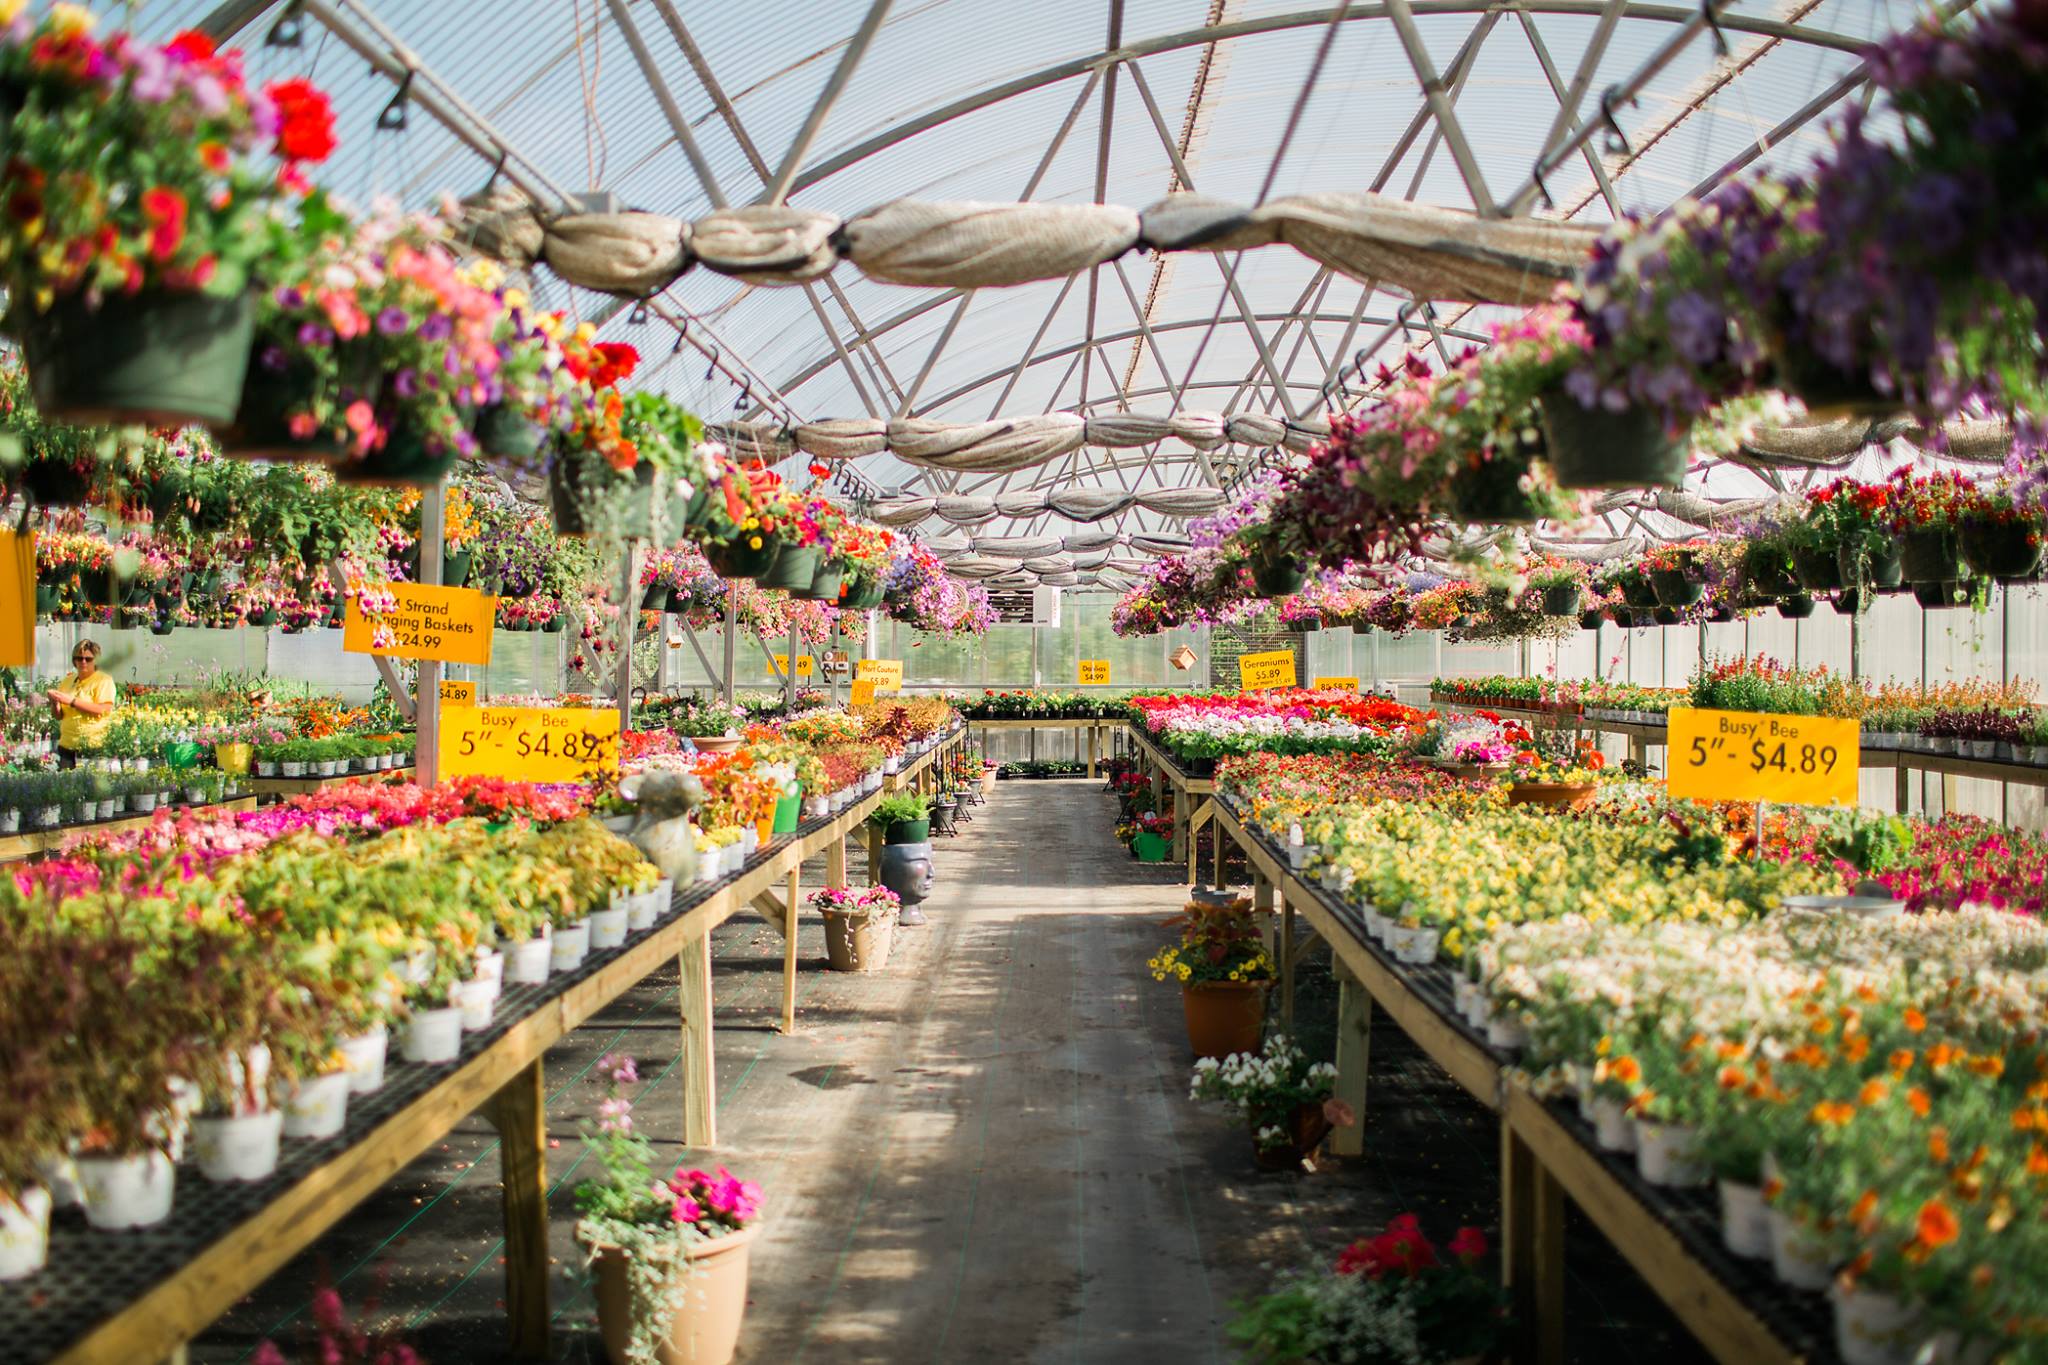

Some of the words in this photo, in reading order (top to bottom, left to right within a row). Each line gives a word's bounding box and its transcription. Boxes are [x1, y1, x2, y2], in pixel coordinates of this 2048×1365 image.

[405, 599, 449, 615] Strand
[363, 610, 420, 631] Hnging
[424, 616, 474, 633] Baskets
[1244, 658, 1290, 669] Geraniums
[1255, 669, 1281, 680] $5.89
[439, 688, 468, 700] $4.89
[481, 711, 517, 730] Busy
[541, 713, 569, 727] Bee
[1719, 716, 1758, 740] Busy
[1770, 720, 1799, 739] Bee
[516, 729, 598, 759] $4.89
[1749, 737, 1838, 775] $4.89
